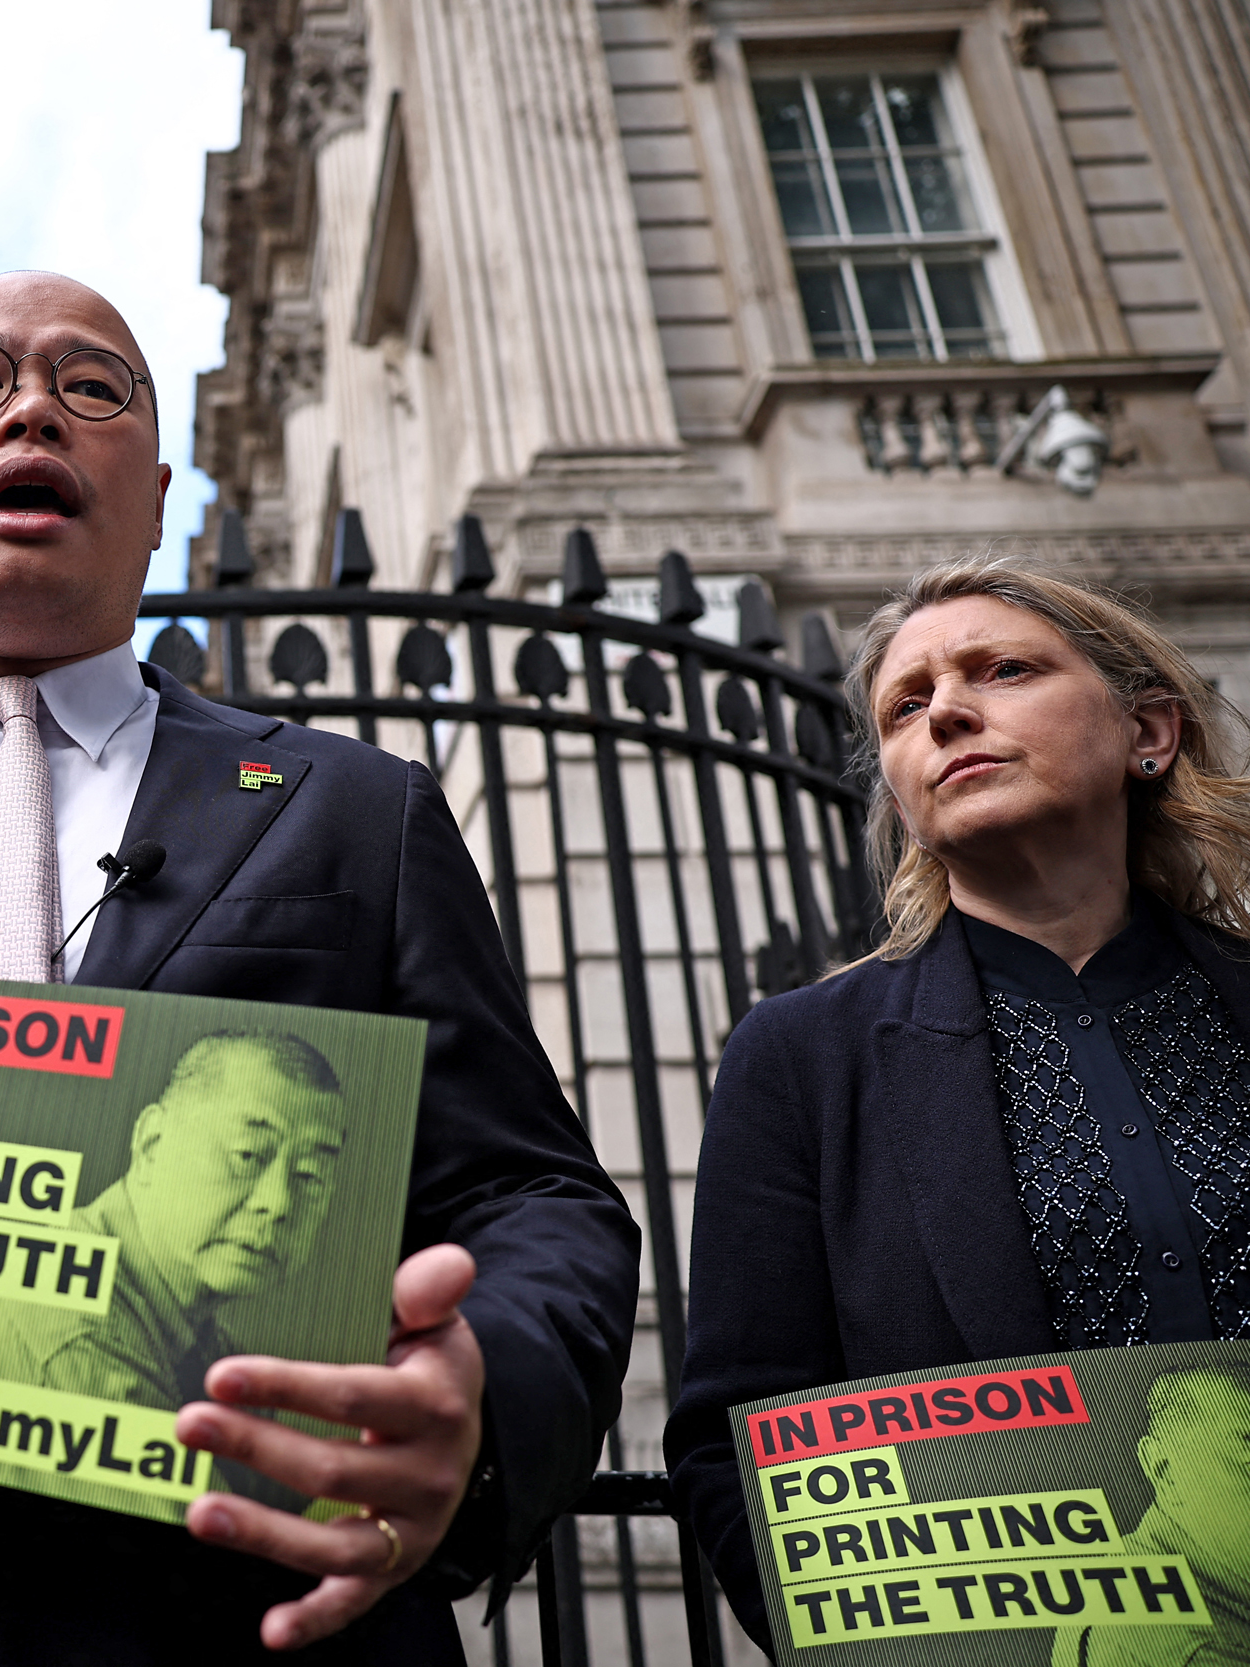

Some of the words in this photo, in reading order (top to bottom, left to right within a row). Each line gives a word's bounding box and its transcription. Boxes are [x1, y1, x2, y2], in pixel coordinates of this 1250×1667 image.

[241, 771, 280, 783] Jimmy
[241, 779, 259, 788] Lai
[242, 763, 269, 772] Free
[757, 1410, 818, 1457] IN
[828, 1375, 1075, 1442] PRISON
[769, 1458, 897, 1513] FOR
[781, 1500, 1110, 1573] PRINTING
[793, 1580, 930, 1635] THE
[937, 1565, 1195, 1621] TRUTH
